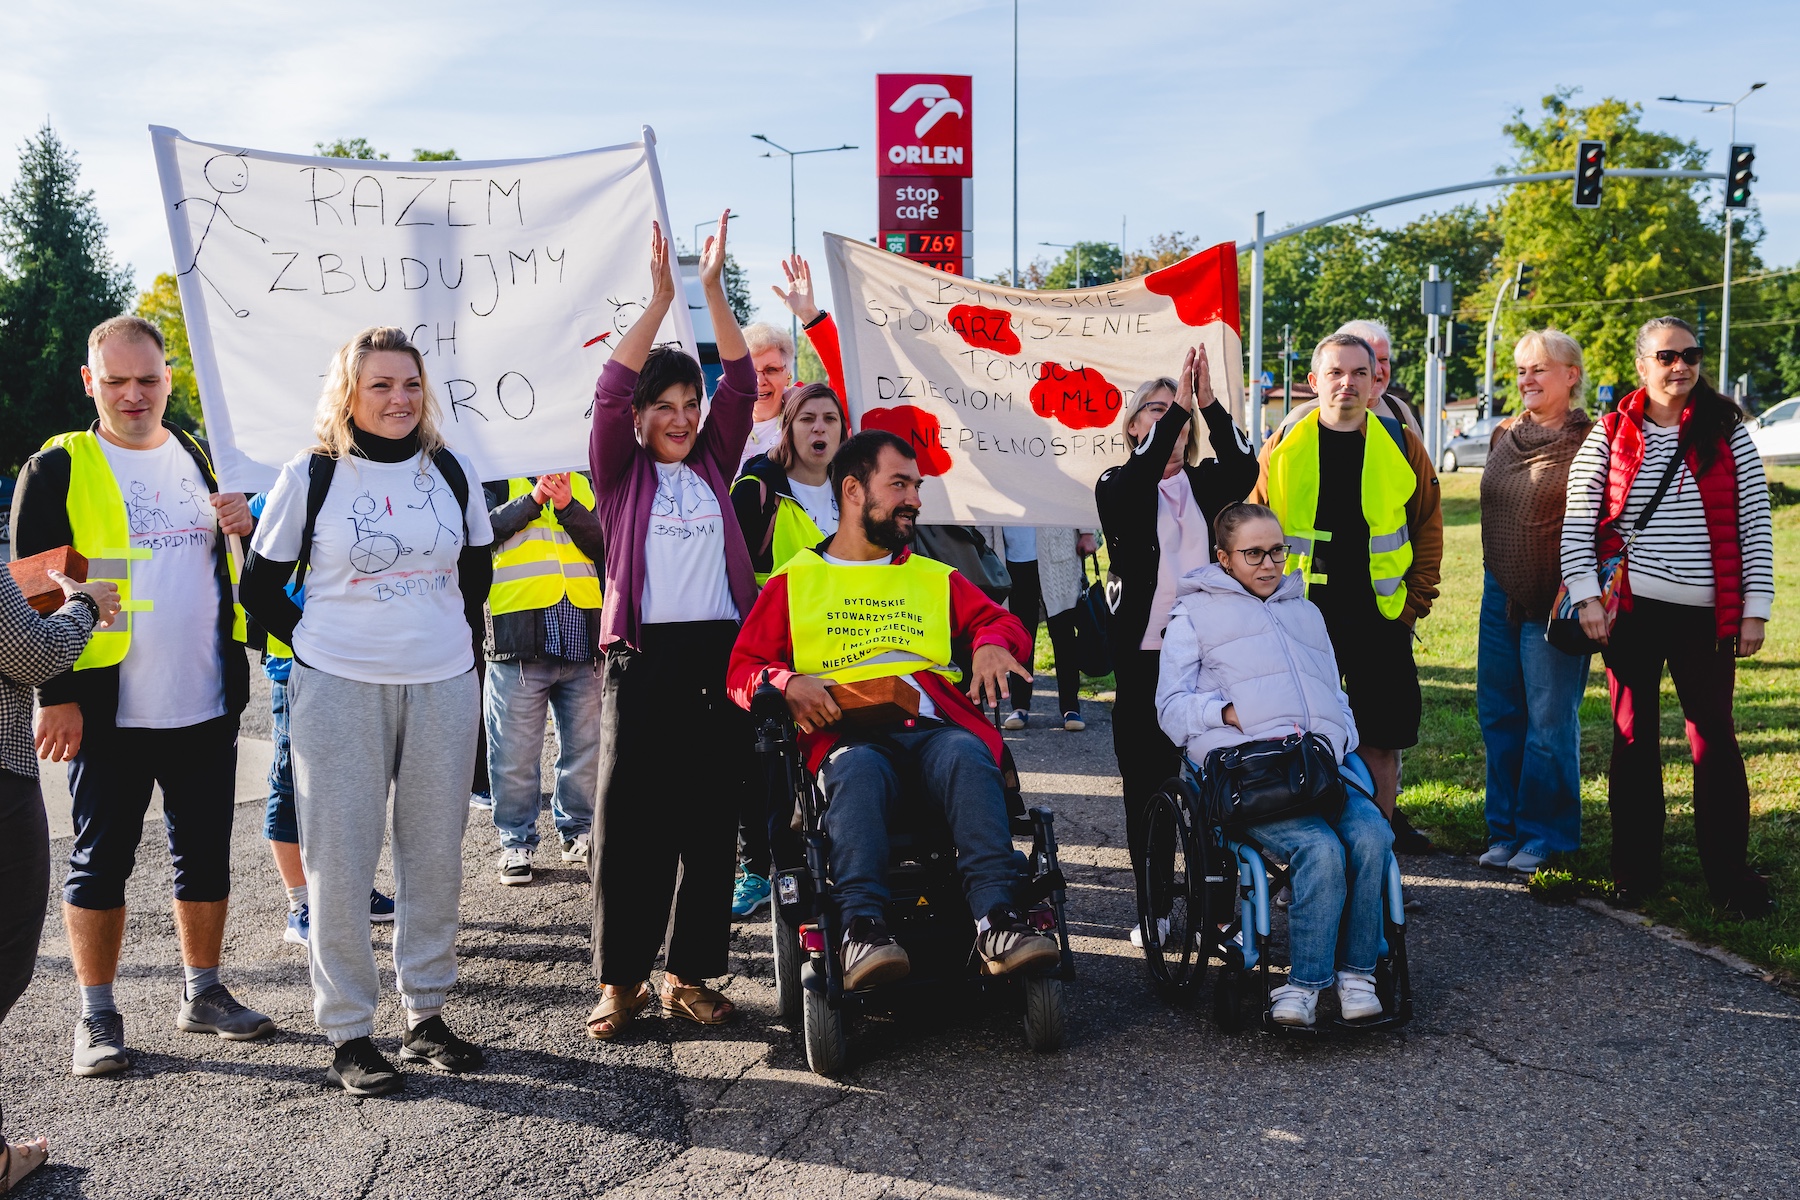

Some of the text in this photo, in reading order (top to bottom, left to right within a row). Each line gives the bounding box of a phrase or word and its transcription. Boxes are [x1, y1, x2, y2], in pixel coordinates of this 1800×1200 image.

[888, 145, 963, 164] ORLEN
[300, 167, 524, 227] RAZEM
[896, 203, 939, 221] cafe
[889, 243, 904, 253] 95
[919, 235, 956, 252] 7.69
[268, 246, 565, 317] ZBUDUJMY
[865, 299, 1151, 343] STOWARZYSZENIE
[409, 321, 457, 356] CH
[959, 350, 1088, 381] POMOCY
[877, 376, 1012, 412] DZIECIOM
[1041, 393, 1047, 412] I
[910, 427, 1125, 458] NIEPEŁNOSPRA
[137, 533, 208, 550] BSPDiMN
[844, 598, 906, 608] BYTOMSKIE
[826, 611, 923, 623] STOWARZYSZENIE
[827, 623, 924, 637] POMOCY DZIECIOM
[842, 636, 911, 651] I MŁODZIEŻY
[822, 647, 878, 669] NIEPEŁNO
